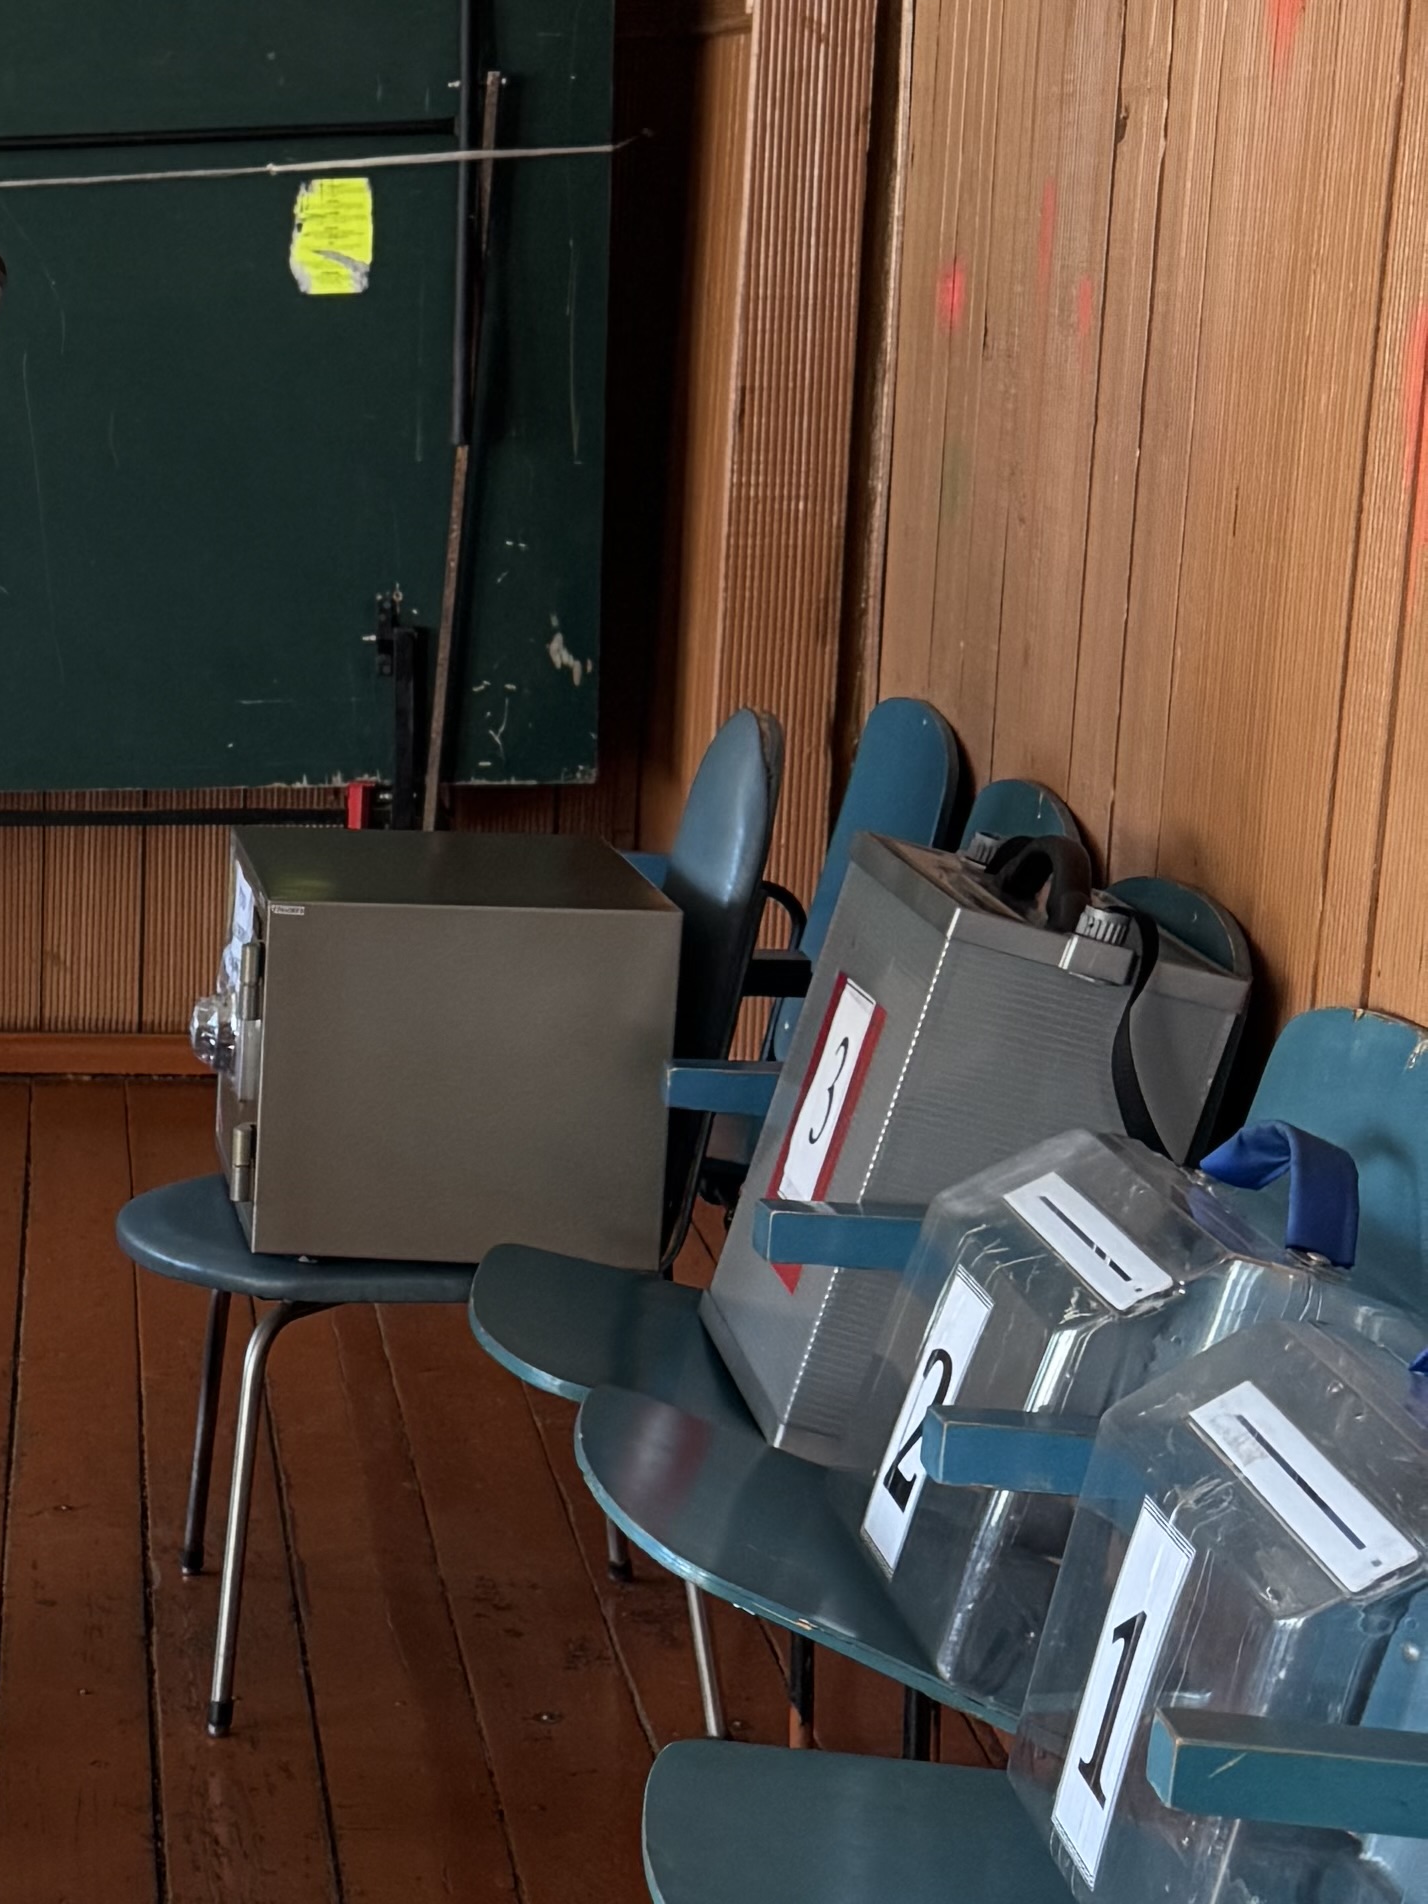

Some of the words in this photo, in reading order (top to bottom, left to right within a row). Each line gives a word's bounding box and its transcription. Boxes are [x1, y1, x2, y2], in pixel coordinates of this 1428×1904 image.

[808, 1036, 849, 1144] 3
[883, 1348, 953, 1513] 2
[1078, 1610, 1147, 1811] 1
